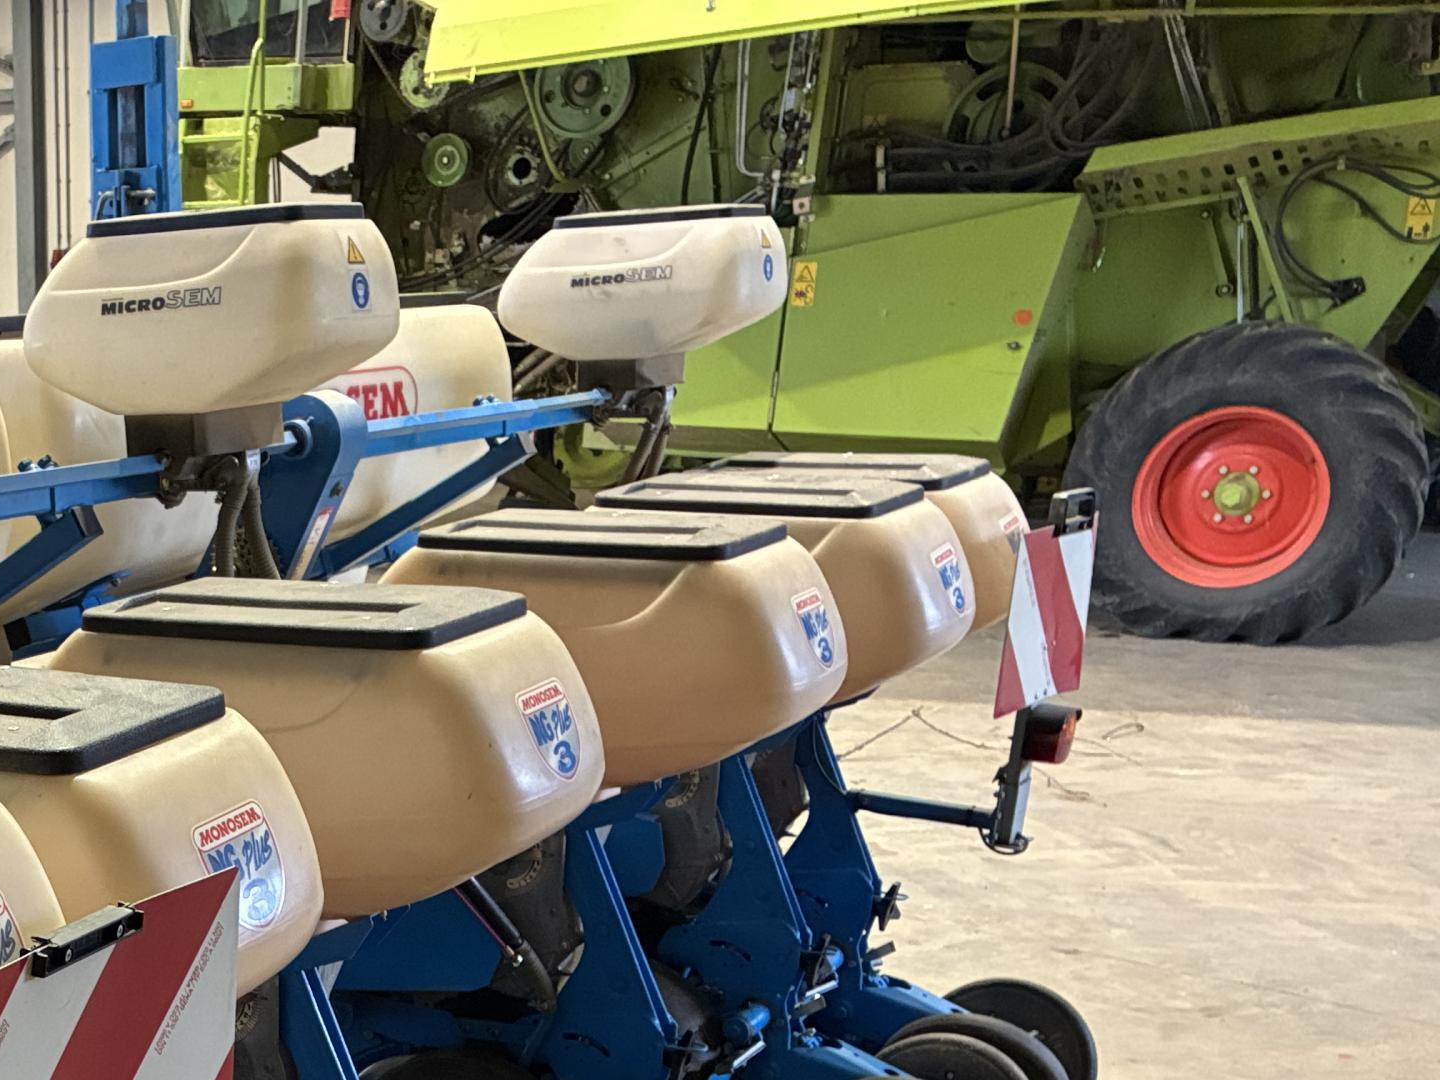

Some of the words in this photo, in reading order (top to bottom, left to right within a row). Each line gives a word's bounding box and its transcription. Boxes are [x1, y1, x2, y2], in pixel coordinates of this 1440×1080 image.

[570, 265, 673, 288] MICROSEM
[101, 286, 222, 315] MICROSEM
[818, 636, 833, 663] 3
[521, 685, 563, 712] MONOSEM
[528, 710, 555, 746] NG
[554, 740, 577, 774] 3
[199, 807, 261, 848] MONOSEM
[242, 878, 276, 921] 3
